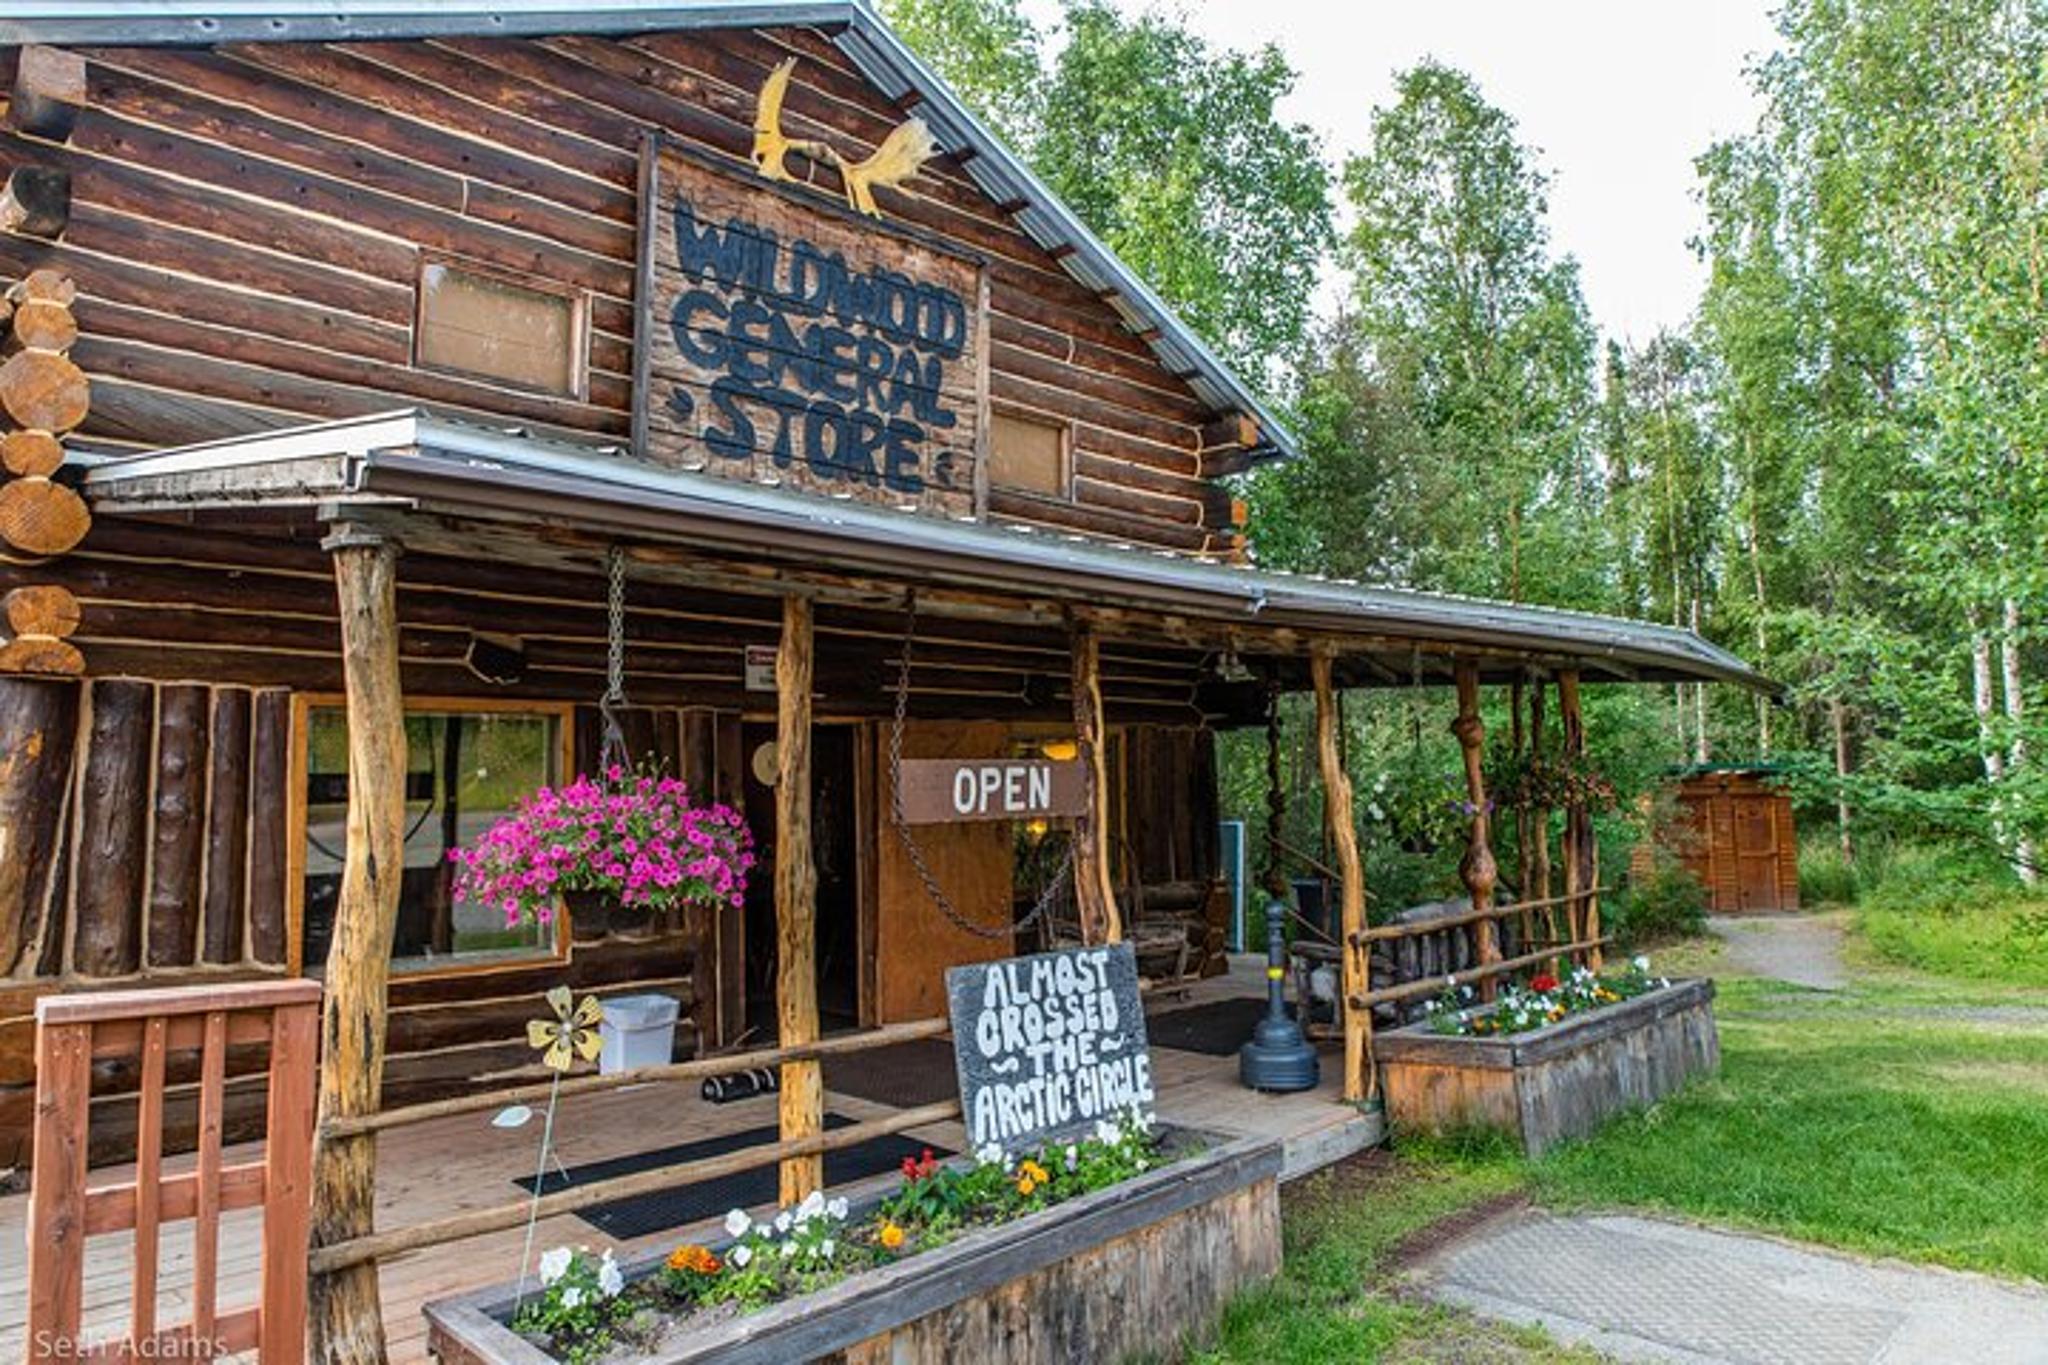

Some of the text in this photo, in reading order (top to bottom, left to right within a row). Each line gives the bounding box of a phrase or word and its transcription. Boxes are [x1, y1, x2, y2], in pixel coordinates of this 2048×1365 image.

[673, 194, 967, 360] WILDWOOD
[671, 289, 957, 428] GENERAL
[705, 375, 926, 494] STORE
[953, 766, 1051, 813] OPEN
[983, 951, 1109, 1008] ALMOST
[976, 989, 1119, 1057] CROSSED
[1026, 1032, 1098, 1076] THE
[974, 1054, 1154, 1144] ARCTIC CIRCLE
